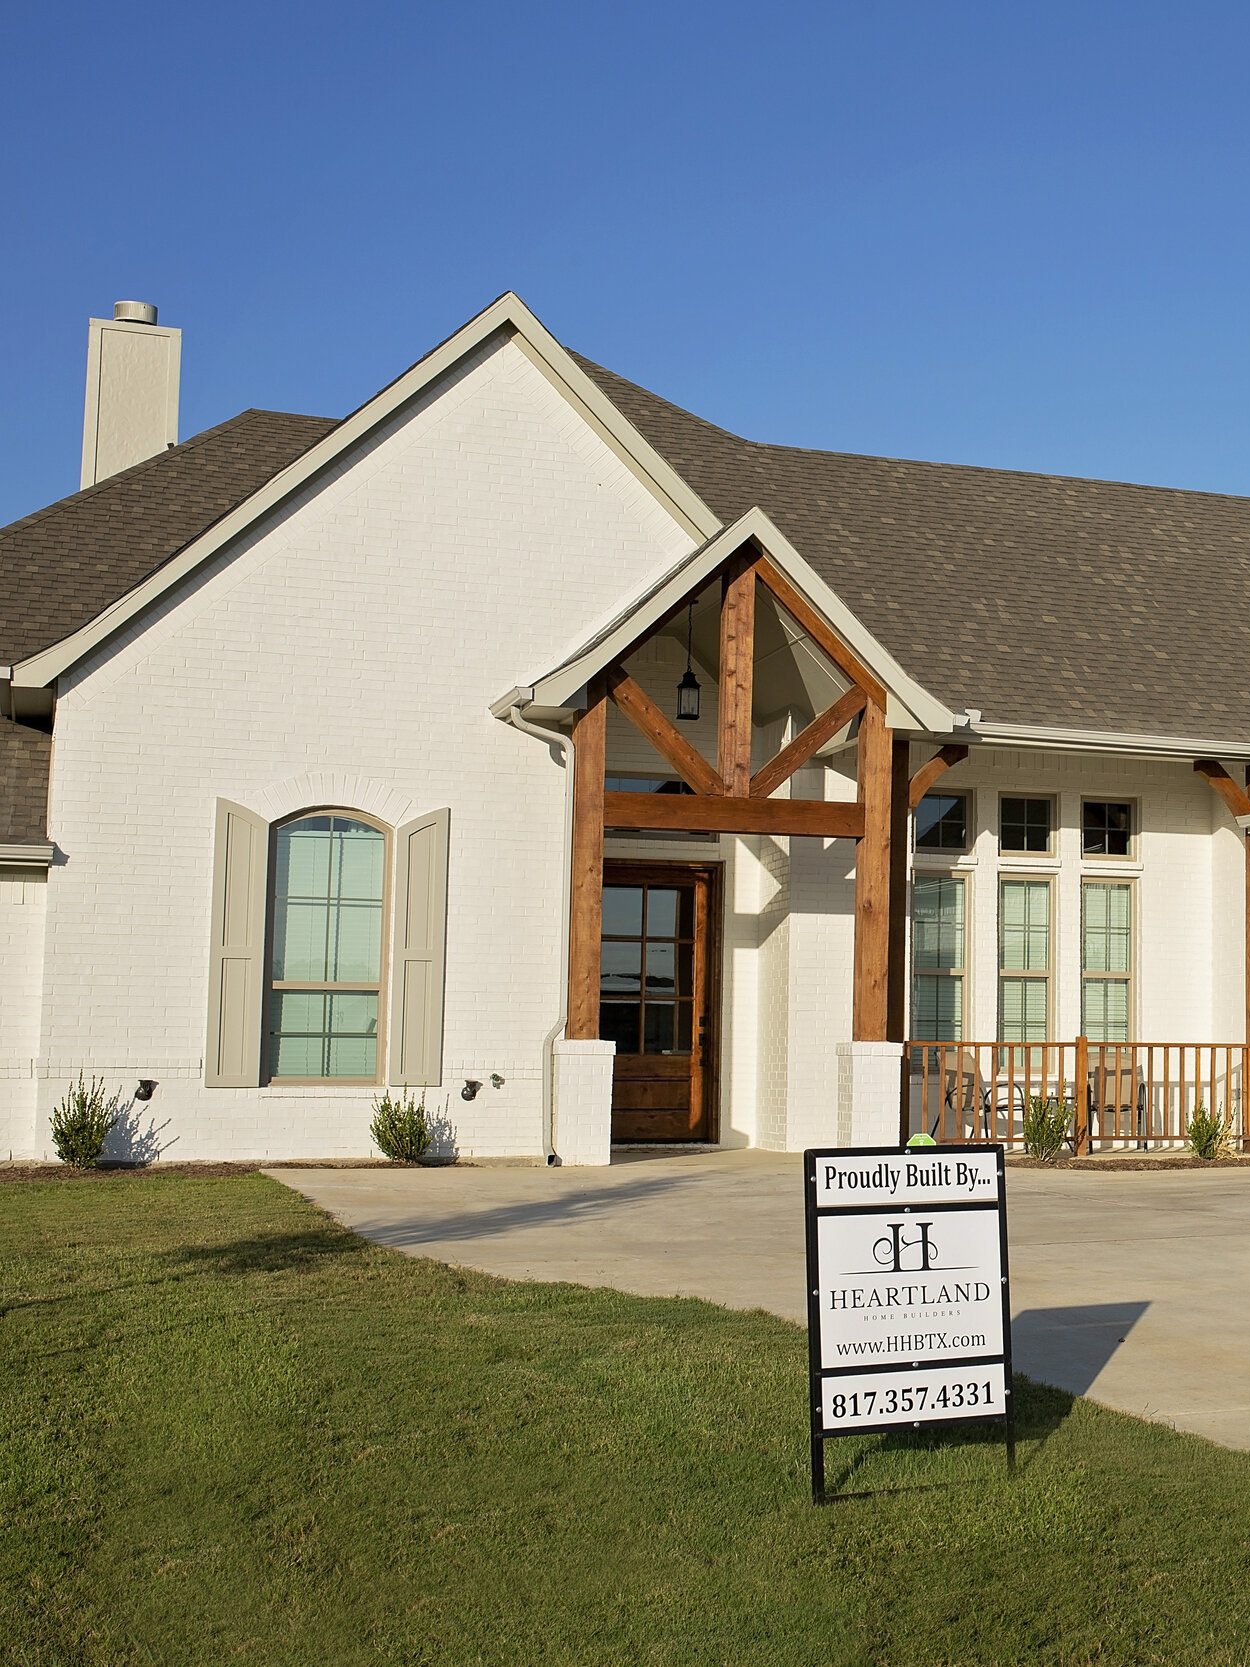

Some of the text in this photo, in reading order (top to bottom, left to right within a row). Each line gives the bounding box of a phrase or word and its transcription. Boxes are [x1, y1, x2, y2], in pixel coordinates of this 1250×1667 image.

[824, 1162, 991, 1194] Proudly Built By...
[829, 1282, 991, 1310] HEARTLAND
[863, 1309, 961, 1322] HOME BUILDERS
[836, 1332, 986, 1356] www.HHBTX.com
[832, 1381, 995, 1419] 817.357.4331
